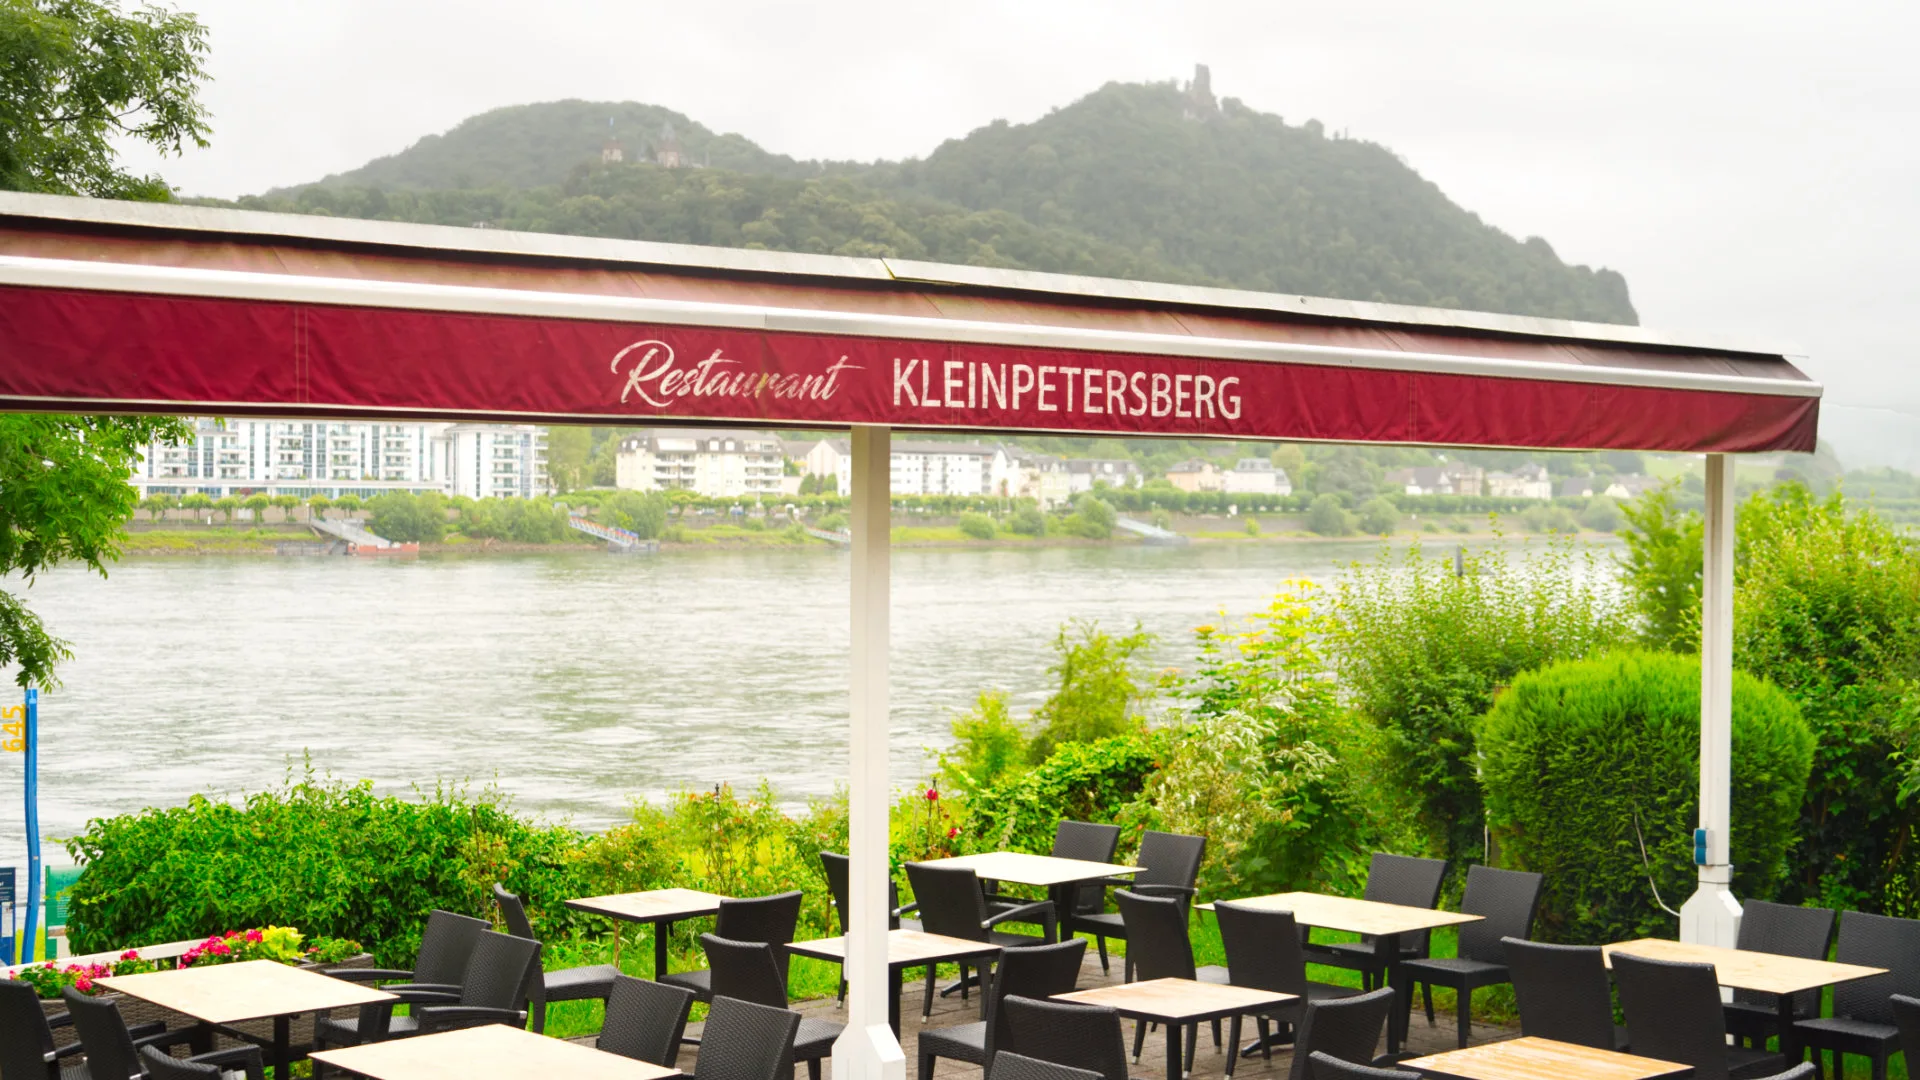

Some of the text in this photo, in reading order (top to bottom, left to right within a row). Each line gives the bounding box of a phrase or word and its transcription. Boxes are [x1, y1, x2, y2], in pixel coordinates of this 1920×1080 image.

[611, 340, 1241, 420] Restaurant KLEINPETERSBERG
[2, 705, 25, 752] 645
